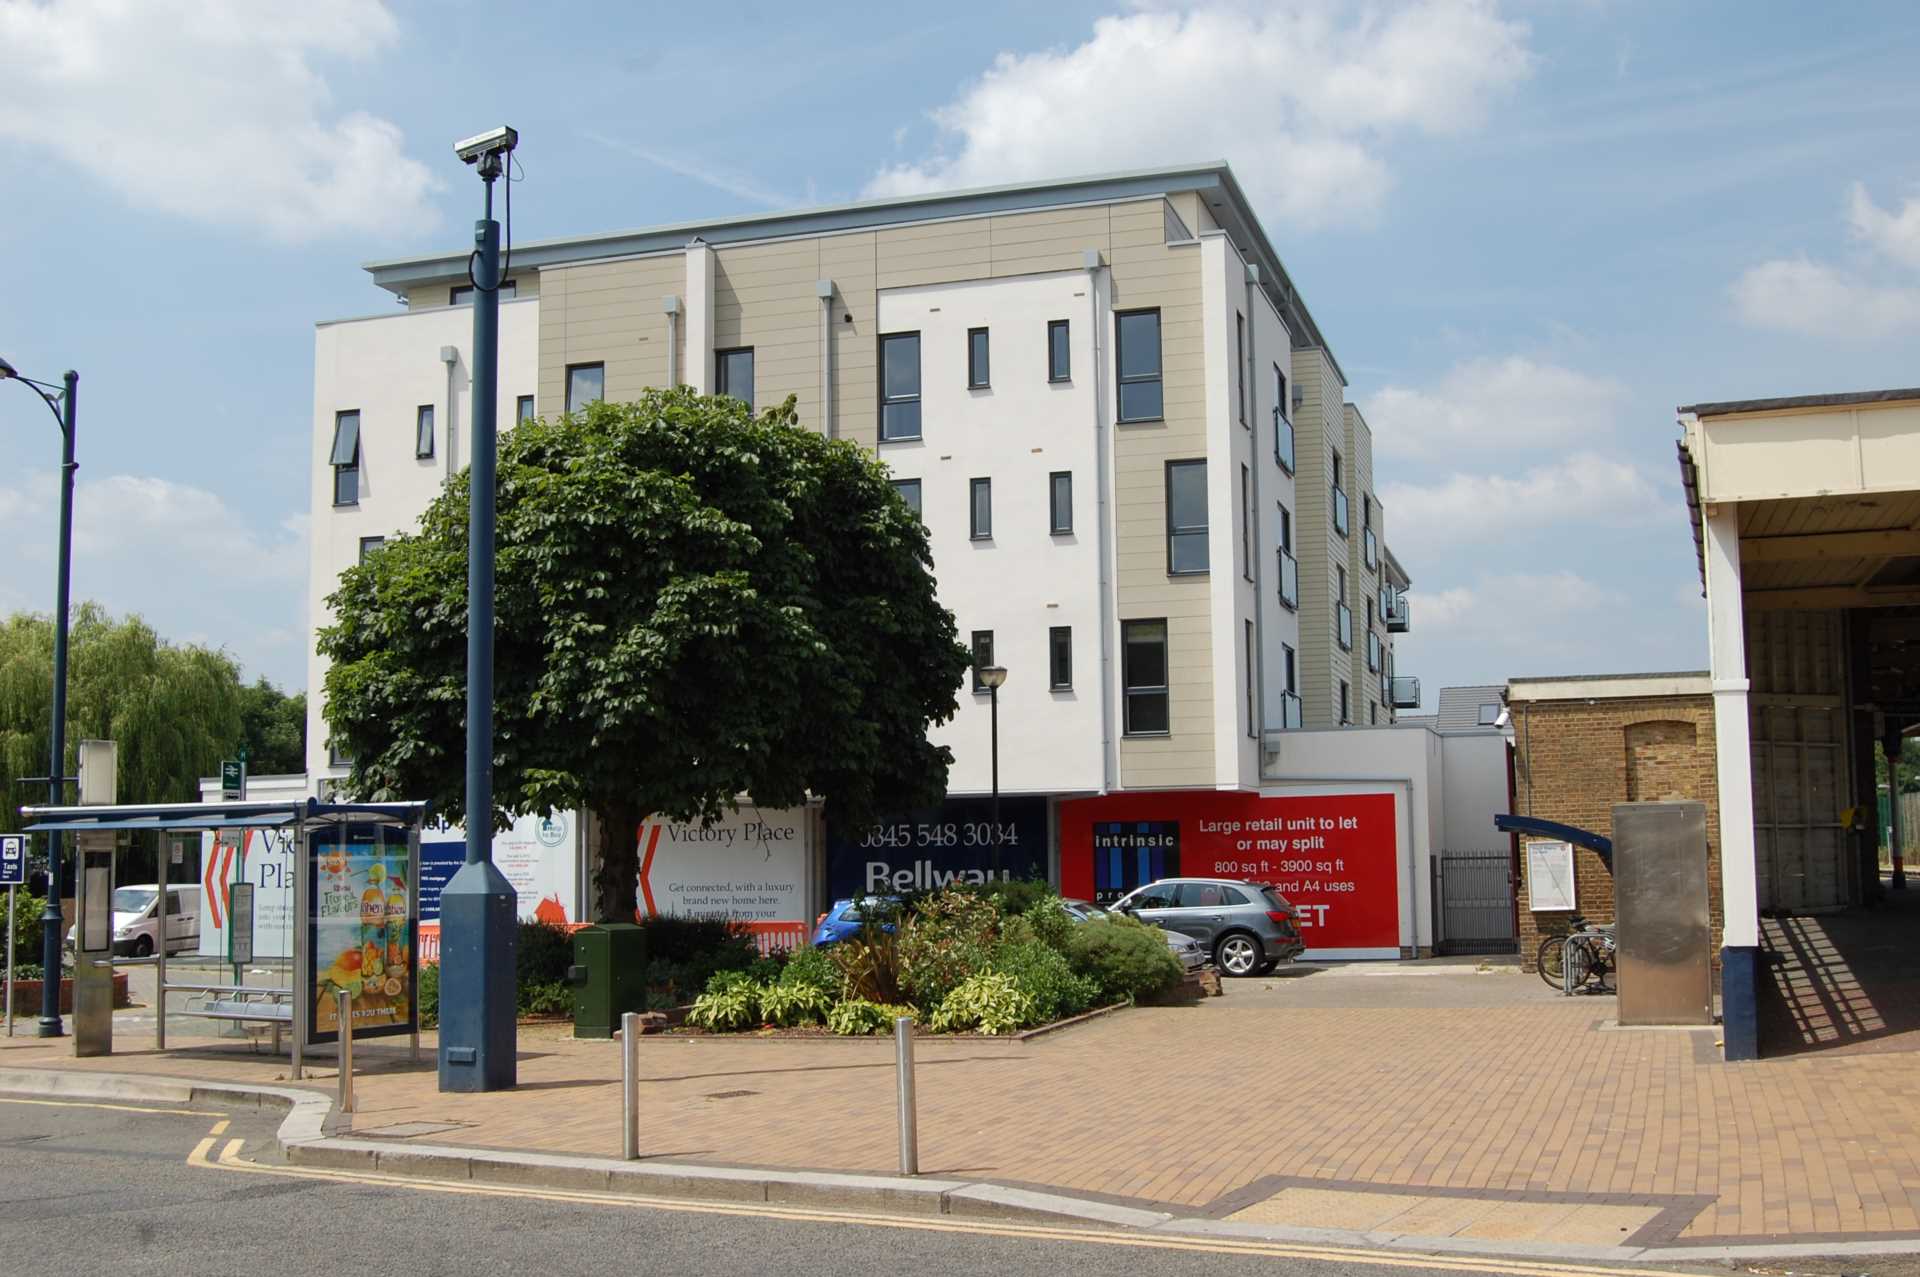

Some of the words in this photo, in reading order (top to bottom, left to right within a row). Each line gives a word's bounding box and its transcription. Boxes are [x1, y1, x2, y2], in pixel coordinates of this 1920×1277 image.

[1200, 819, 1241, 834] Large
[1245, 818, 1282, 831] retail
[1287, 817, 1316, 830] unit
[1319, 817, 1334, 830] to
[1339, 816, 1358, 829] let
[667, 824, 737, 847] Victory
[743, 822, 795, 841] Place
[916, 823, 957, 847] 548
[963, 822, 1019, 846] 3034
[1095, 834, 1174, 848] intrinsic
[1236, 839, 1252, 850] or
[1256, 838, 1288, 852] may
[1292, 836, 1325, 852] split
[1214, 861, 1238, 873] 800
[1241, 863, 1257, 874] sq
[1260, 860, 1269, 872] ft
[1280, 860, 1313, 872] 3900
[1315, 861, 1332, 874] sq
[1335, 859, 1345, 871] ft
[668, 882, 685, 893] Get
[686, 881, 734, 894] connected,
[735, 881, 756, 892] with
[757, 884, 764, 892] a
[765, 881, 795, 895] luxury
[1275, 881, 1299, 892] and
[1303, 880, 1320, 892] A4
[1324, 881, 1355, 892] uses
[682, 895, 709, 905] brand
[710, 897, 729, 905] new
[731, 895, 756, 905] home
[732, 908, 753, 918] from
[754, 910, 777, 920] your
